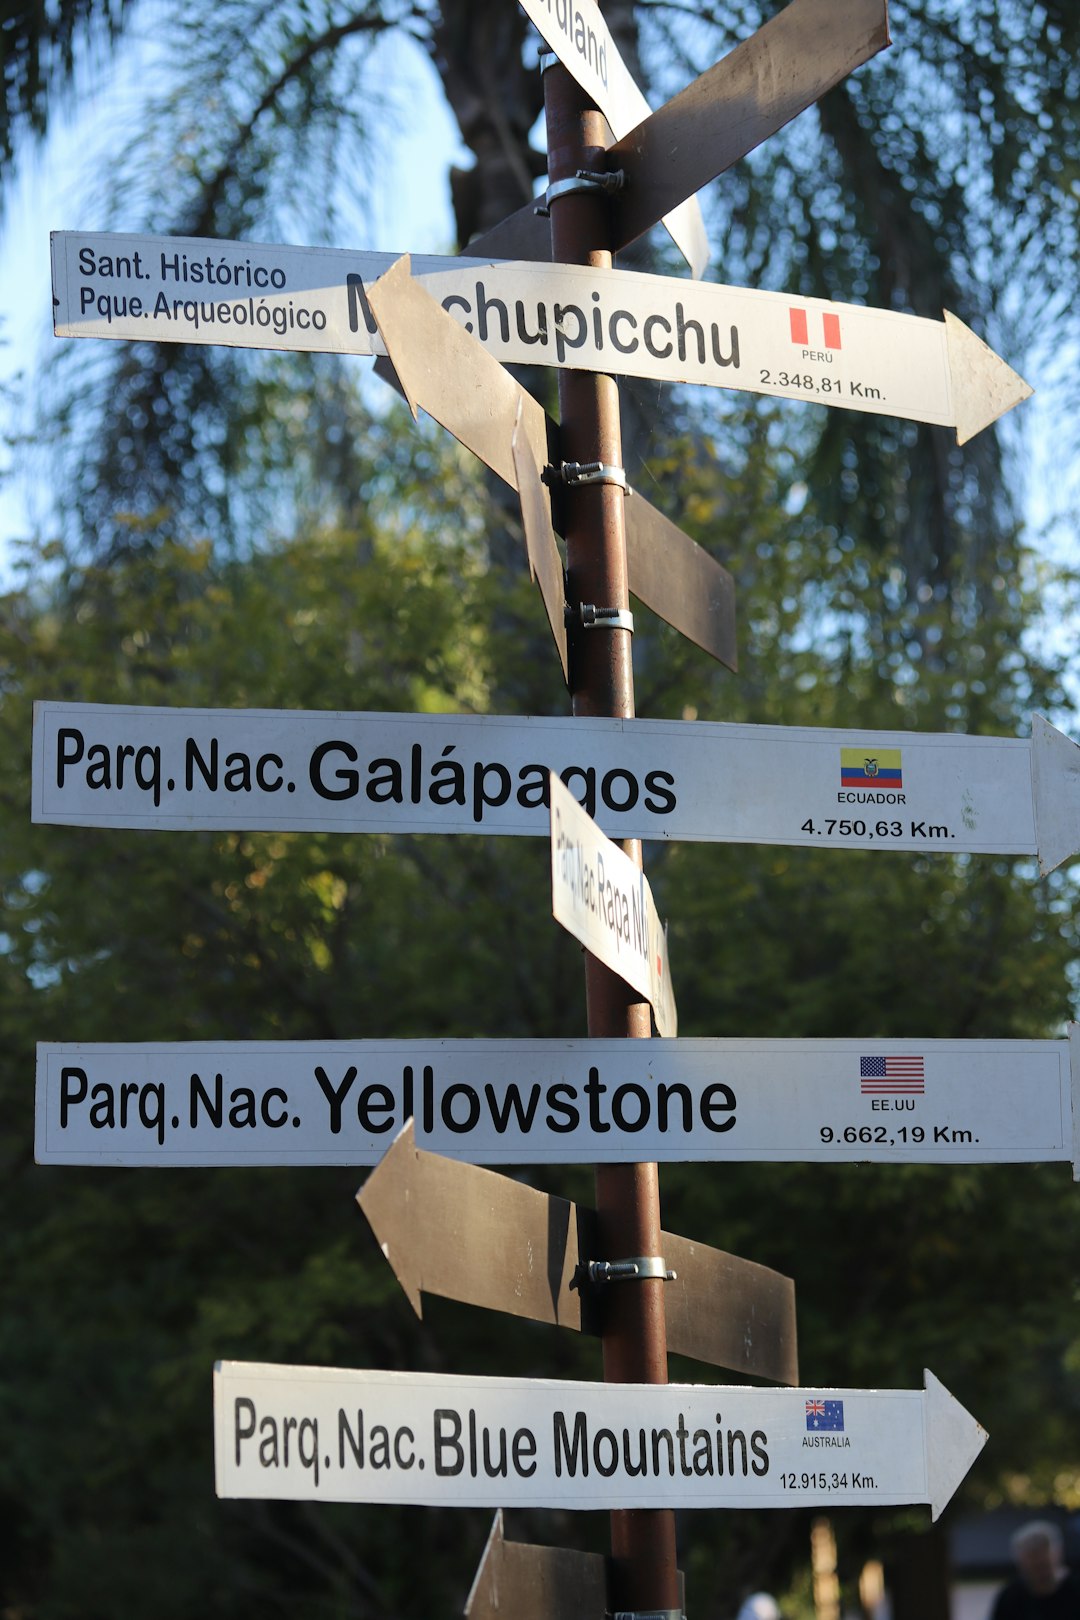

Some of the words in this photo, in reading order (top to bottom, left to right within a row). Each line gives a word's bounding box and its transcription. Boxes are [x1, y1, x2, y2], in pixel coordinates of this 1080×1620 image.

[79, 248, 151, 280] Sant.
[160, 252, 287, 289] Histórico
[346, 273, 741, 369] Mchupicchu
[801, 349, 834, 364] PERÚ
[759, 369, 843, 394] 2.348,81
[850, 381, 887, 401] Km.
[57, 728, 176, 808] Parq.
[185, 737, 296, 793] Nac.
[309, 740, 678, 823] Galápagos
[837, 792, 907, 805] ECUADOR
[801, 818, 903, 839] 4.750,63
[911, 821, 956, 839] Km.
[598, 851, 631, 954] Rapa
[60, 1067, 180, 1146] Parq.
[190, 1073, 301, 1129] Nac.
[314, 1065, 738, 1134] Yellowstone
[871, 1099, 916, 1111] EE.UU
[819, 1126, 926, 1146] 9.662,19
[933, 1126, 980, 1143] Km.
[234, 1397, 331, 1488] Parq.
[338, 1408, 426, 1471] Nac.
[433, 1408, 538, 1479] Blue
[553, 1411, 771, 1478] Mountains
[802, 1436, 851, 1448] AUSTRALIA
[779, 1472, 849, 1492] 12.915,34
[851, 1472, 879, 1489] Km.
